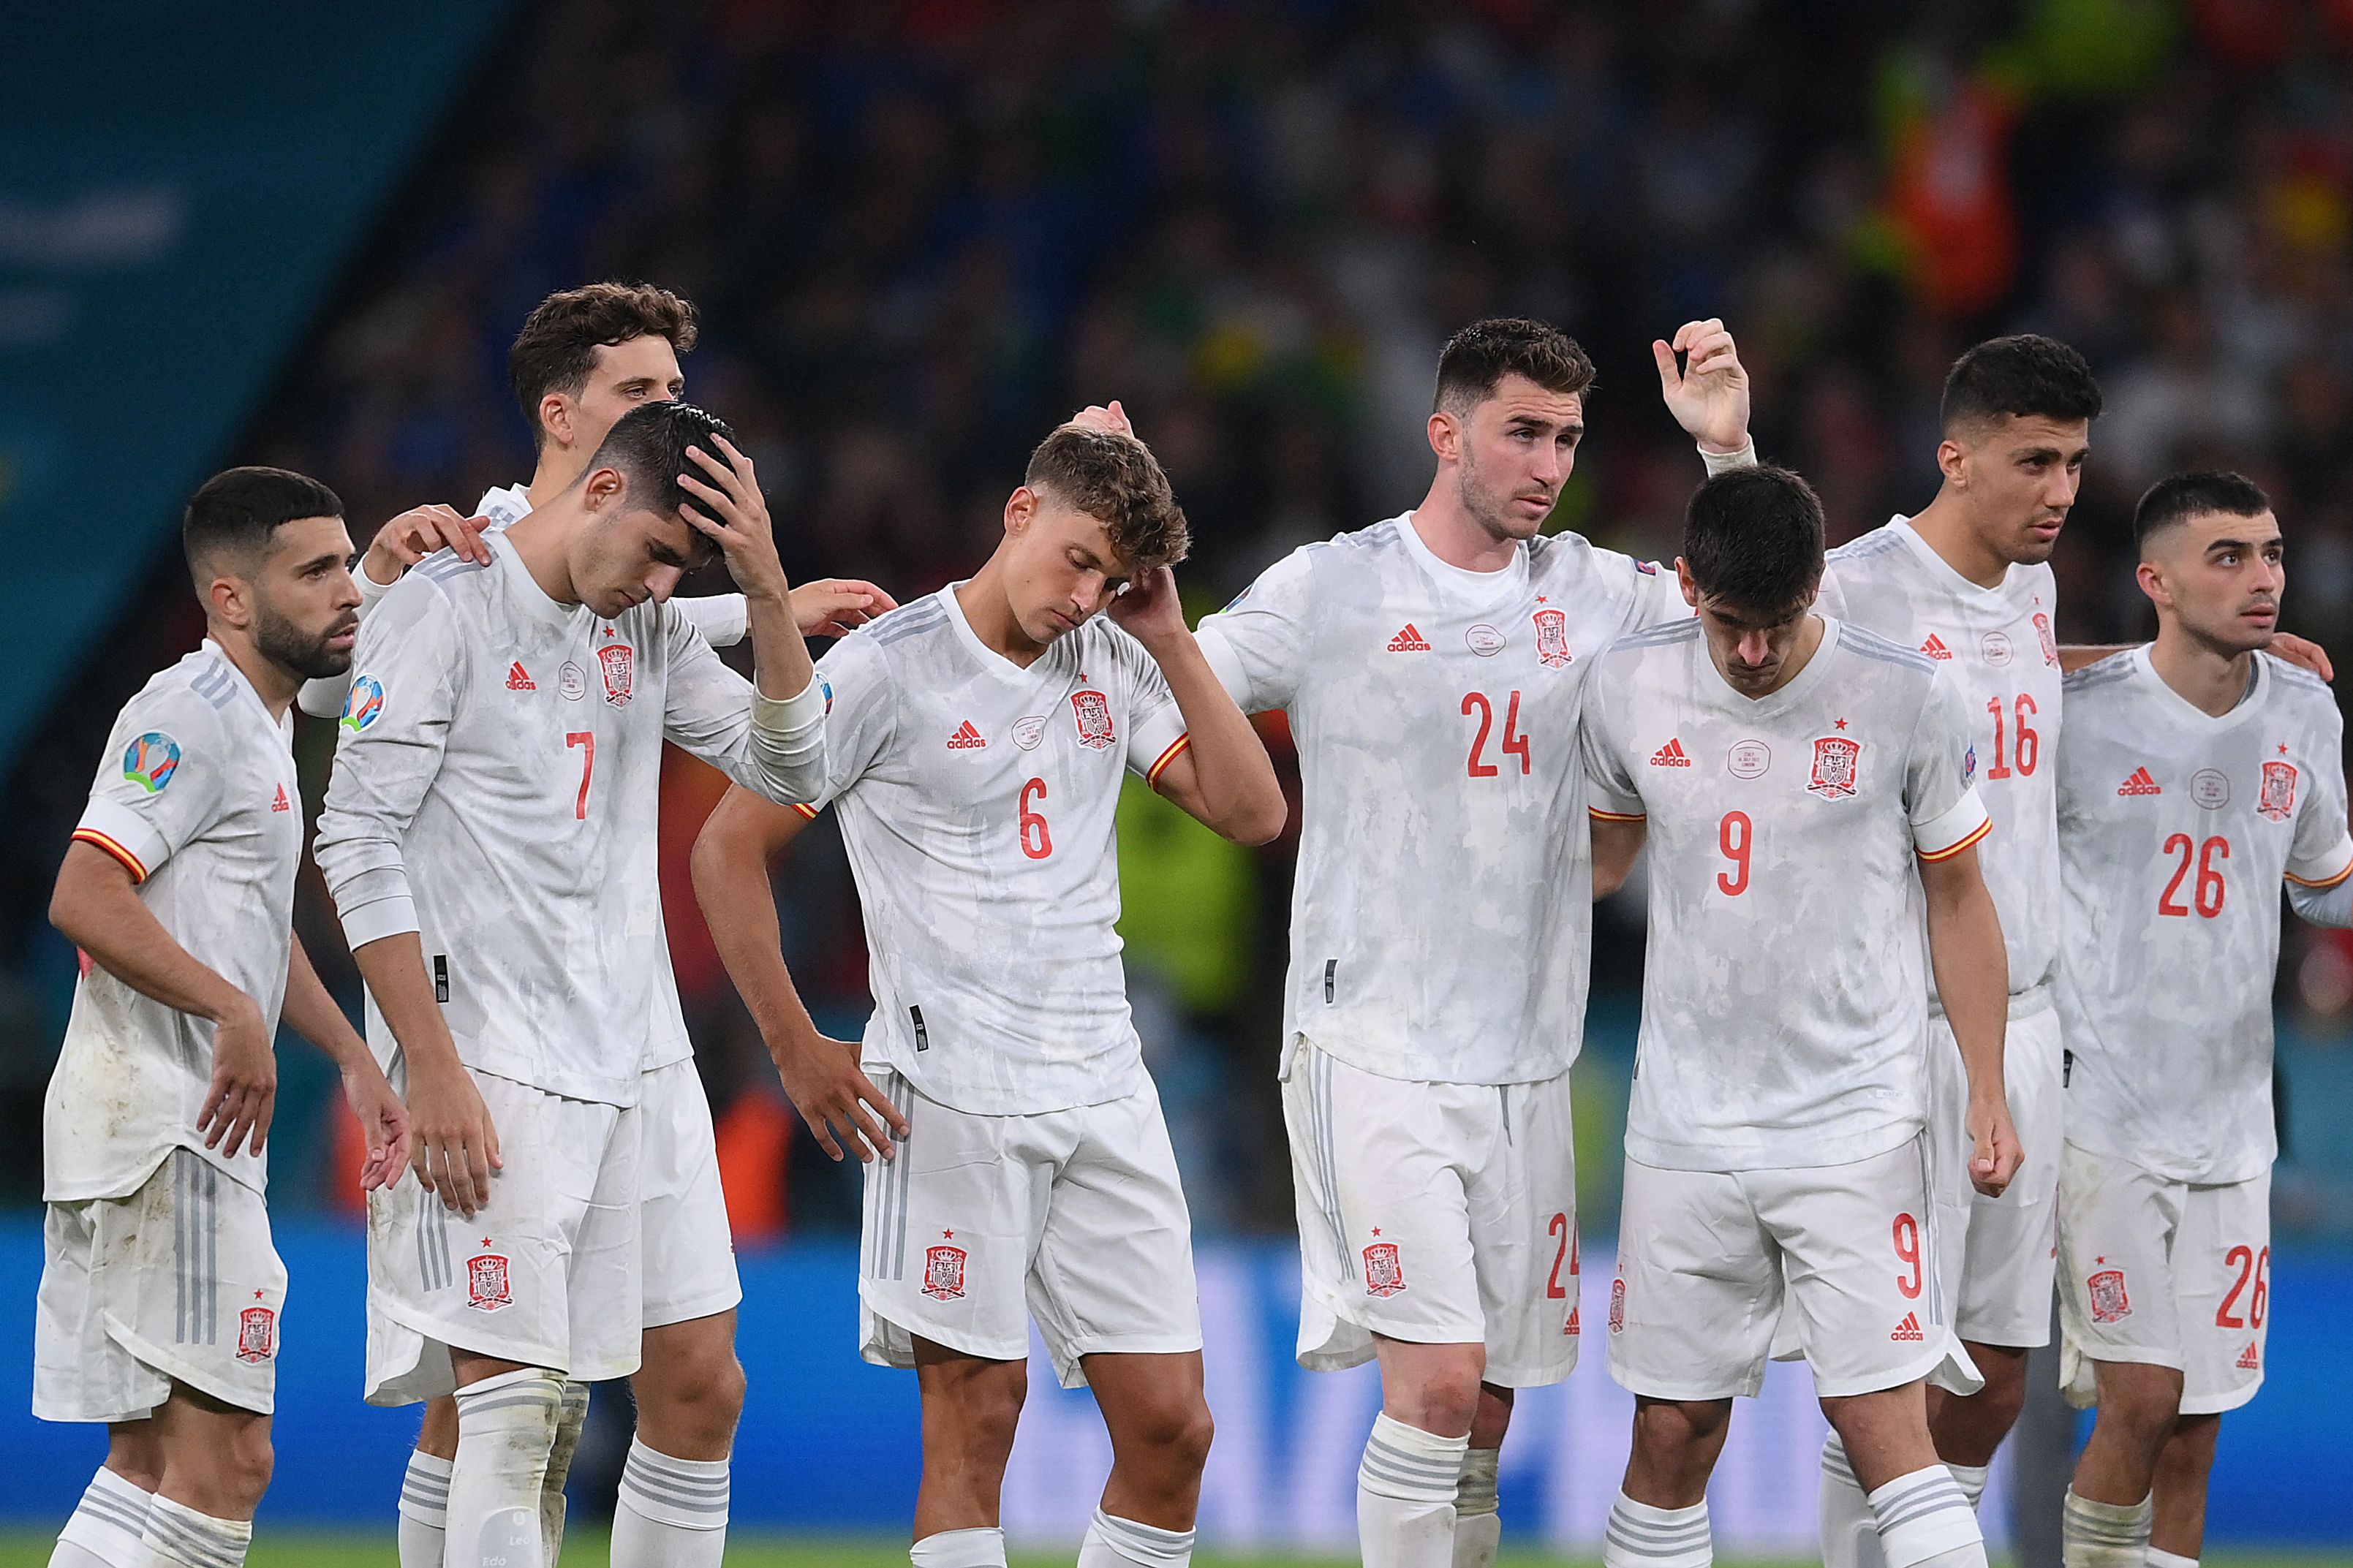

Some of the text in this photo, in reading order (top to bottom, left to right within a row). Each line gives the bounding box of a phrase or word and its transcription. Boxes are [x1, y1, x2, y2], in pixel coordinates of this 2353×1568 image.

[505, 678, 537, 691] adidas
[1386, 640, 1432, 652] adidas
[567, 732, 595, 819] 7
[946, 736, 986, 749] adidas
[1462, 690, 1531, 778] 24
[1650, 754, 1691, 768] adidas
[1987, 693, 2039, 780] 16
[1020, 777, 1053, 860] 6
[2118, 784, 2162, 796] adidas
[1718, 811, 1753, 897] 9
[2159, 833, 2230, 919] 26
[1892, 1212, 1922, 1299] 9
[2216, 1245, 2270, 1330] 26
[1891, 1330, 1925, 1341] adidas
[509, 1536, 530, 1546] Leo
